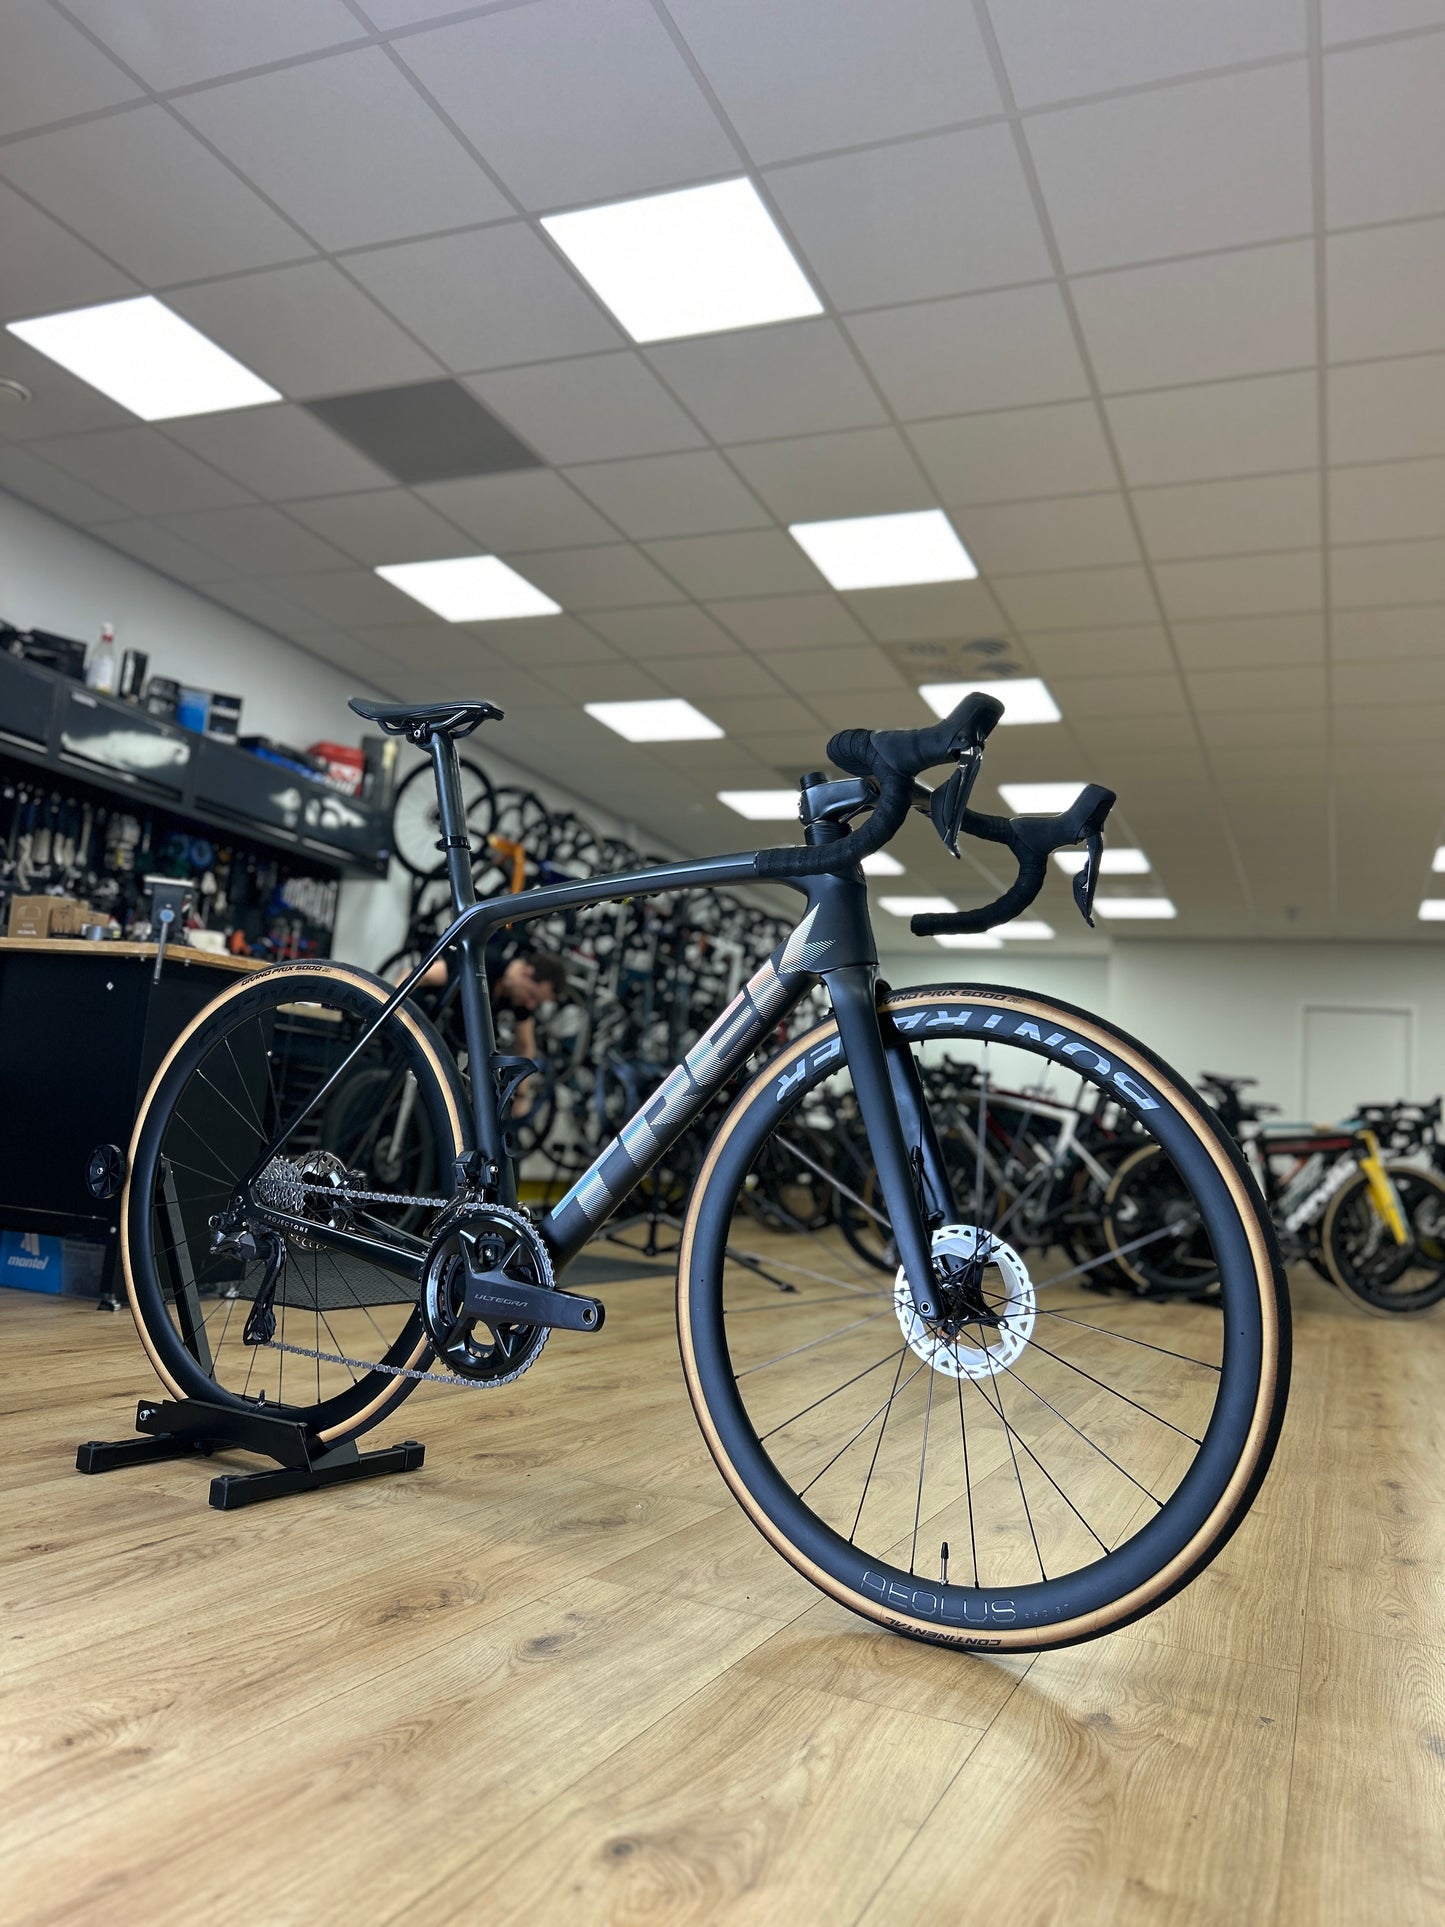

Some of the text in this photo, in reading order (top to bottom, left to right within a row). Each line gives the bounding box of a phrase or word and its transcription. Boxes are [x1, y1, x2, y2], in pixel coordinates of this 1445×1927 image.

[241, 971, 271, 986] GRAND
[271, 966, 295, 975] PRIX
[919, 990, 958, 998] PRIX
[958, 990, 1007, 1001] 5000
[551, 903, 836, 1223] TREK
[776, 1010, 1162, 1111] BONTRAER
[8, 1256, 49, 1270] mantel
[474, 1293, 529, 1308] ULTEGRA
[860, 1571, 1016, 1623] AEOLUS
[886, 1616, 1002, 1647] CONTINENTAL
